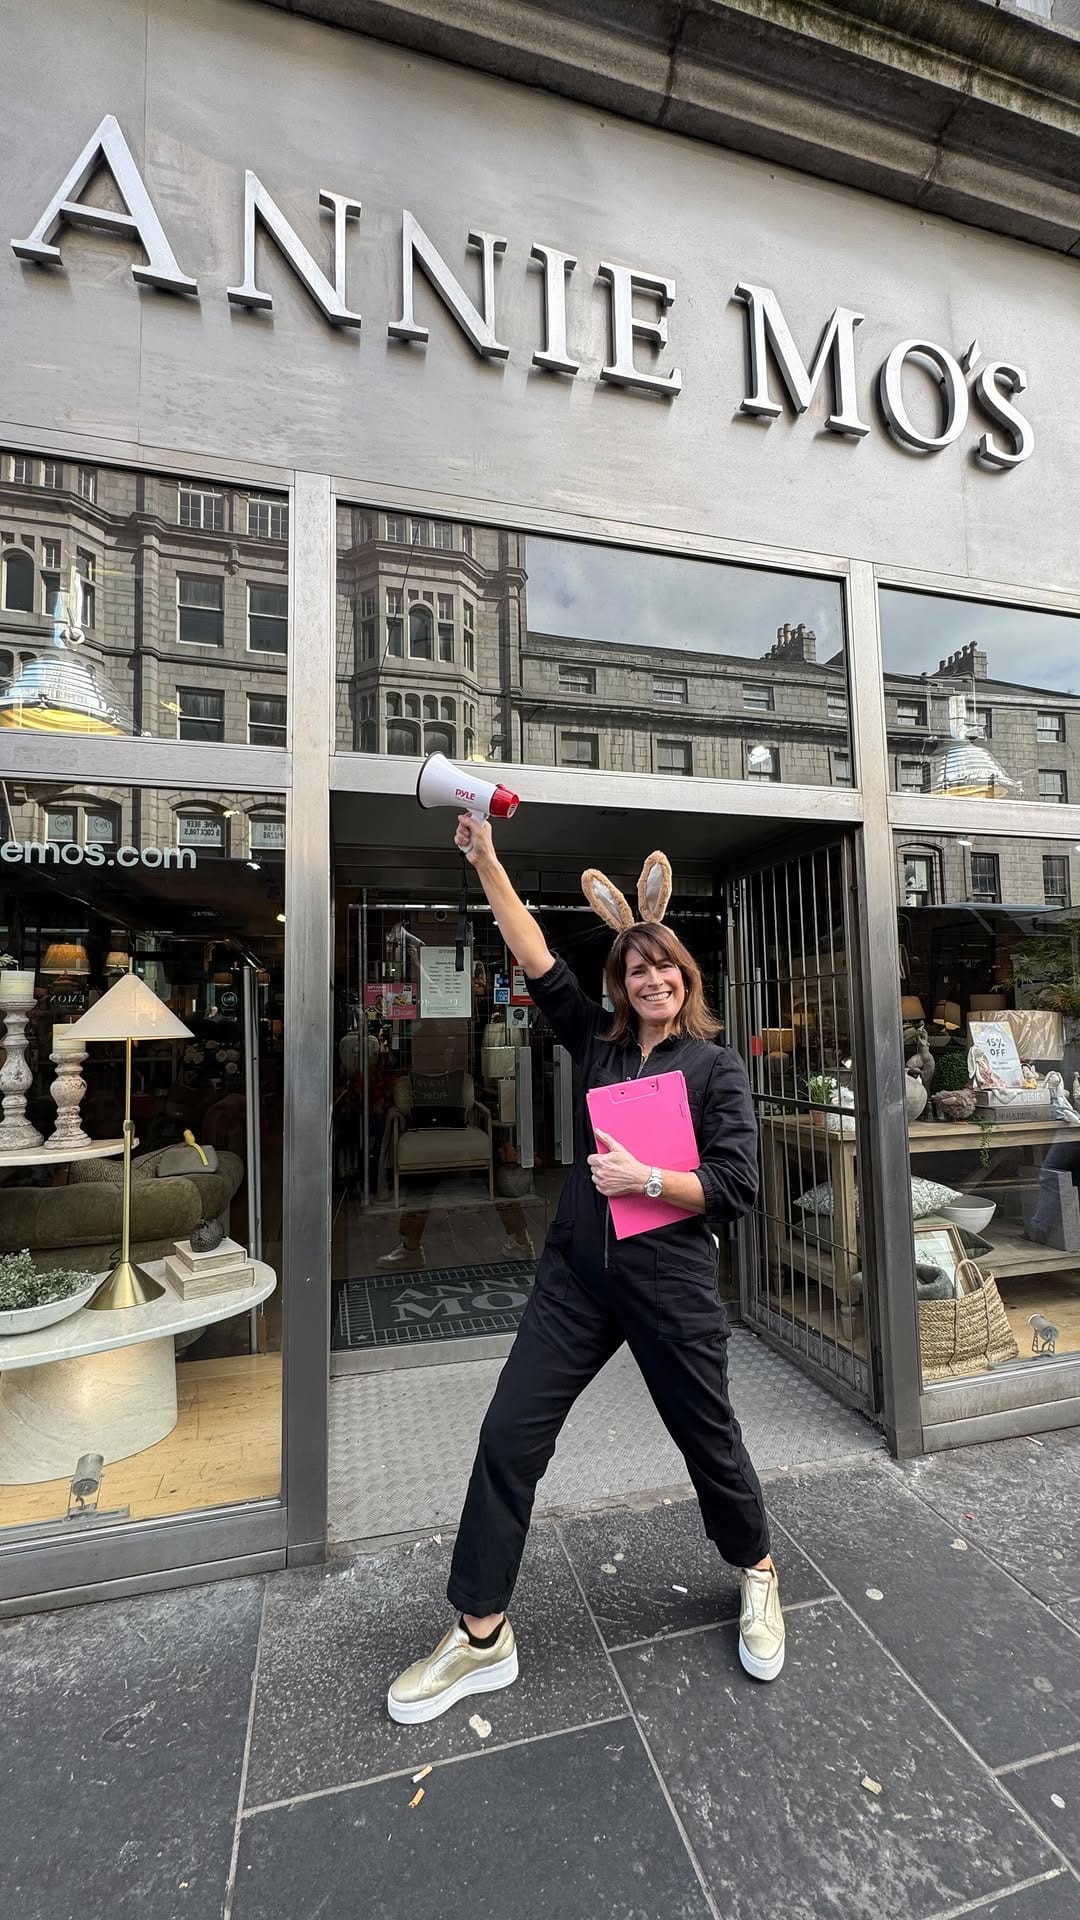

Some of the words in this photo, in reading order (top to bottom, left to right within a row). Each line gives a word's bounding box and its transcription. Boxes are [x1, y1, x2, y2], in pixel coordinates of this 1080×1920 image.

[11, 114, 682, 396] ANNIE
[732, 281, 1035, 469] MO'S
[455, 788, 476, 801] PYLE
[1, 840, 197, 869] emos.com
[986, 1038, 1005, 1048] 15%
[391, 1274, 536, 1303] ANNI
